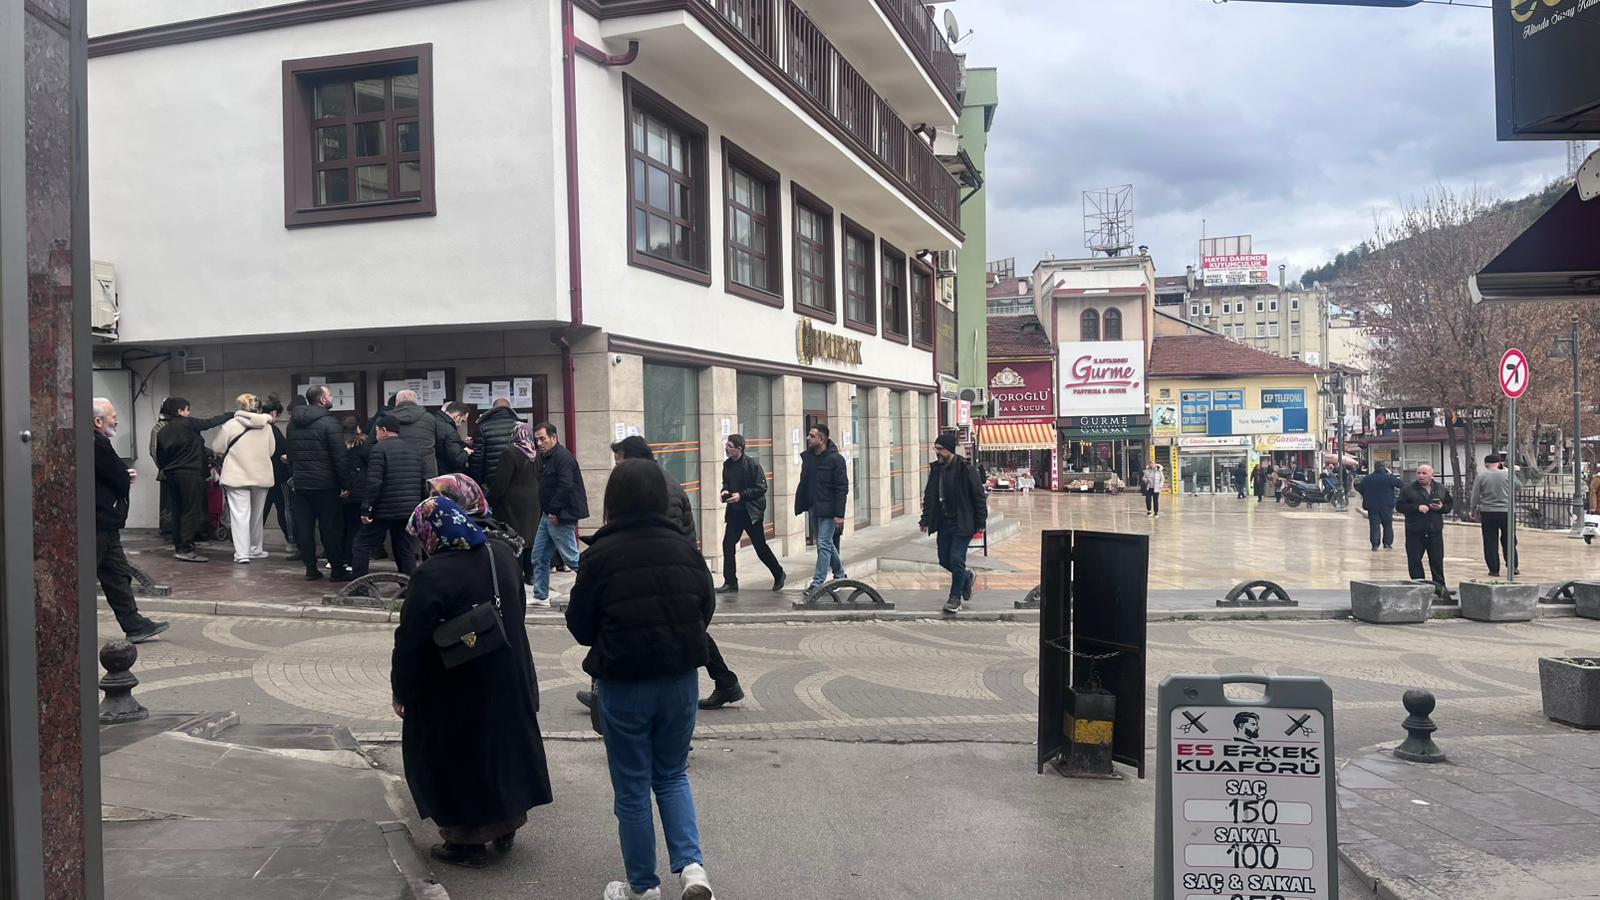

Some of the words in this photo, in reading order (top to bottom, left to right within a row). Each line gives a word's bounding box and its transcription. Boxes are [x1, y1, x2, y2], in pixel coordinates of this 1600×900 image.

[1209, 260, 1262, 268] KUYUMCULUK
[1072, 355, 1136, 381] Gurme
[1263, 394, 1274, 403] CEP
[1274, 393, 1302, 403] TELEFONU
[1019, 404, 1046, 412] SUCUK
[1405, 410, 1431, 419] EKMEK
[1080, 416, 1128, 426] GURME
[1177, 743, 1214, 756] ES
[1223, 744, 1320, 760] ERKEK
[1176, 758, 1321, 775] KUAFÖRÜ
[1225, 779, 1268, 799] SAÇ
[1227, 798, 1278, 825] 150
[1214, 826, 1281, 844] SAKAL
[1226, 843, 1279, 869] 100
[1183, 873, 1224, 894] SAÇ
[1228, 873, 1244, 891] &
[1248, 875, 1316, 893] SAKAL
